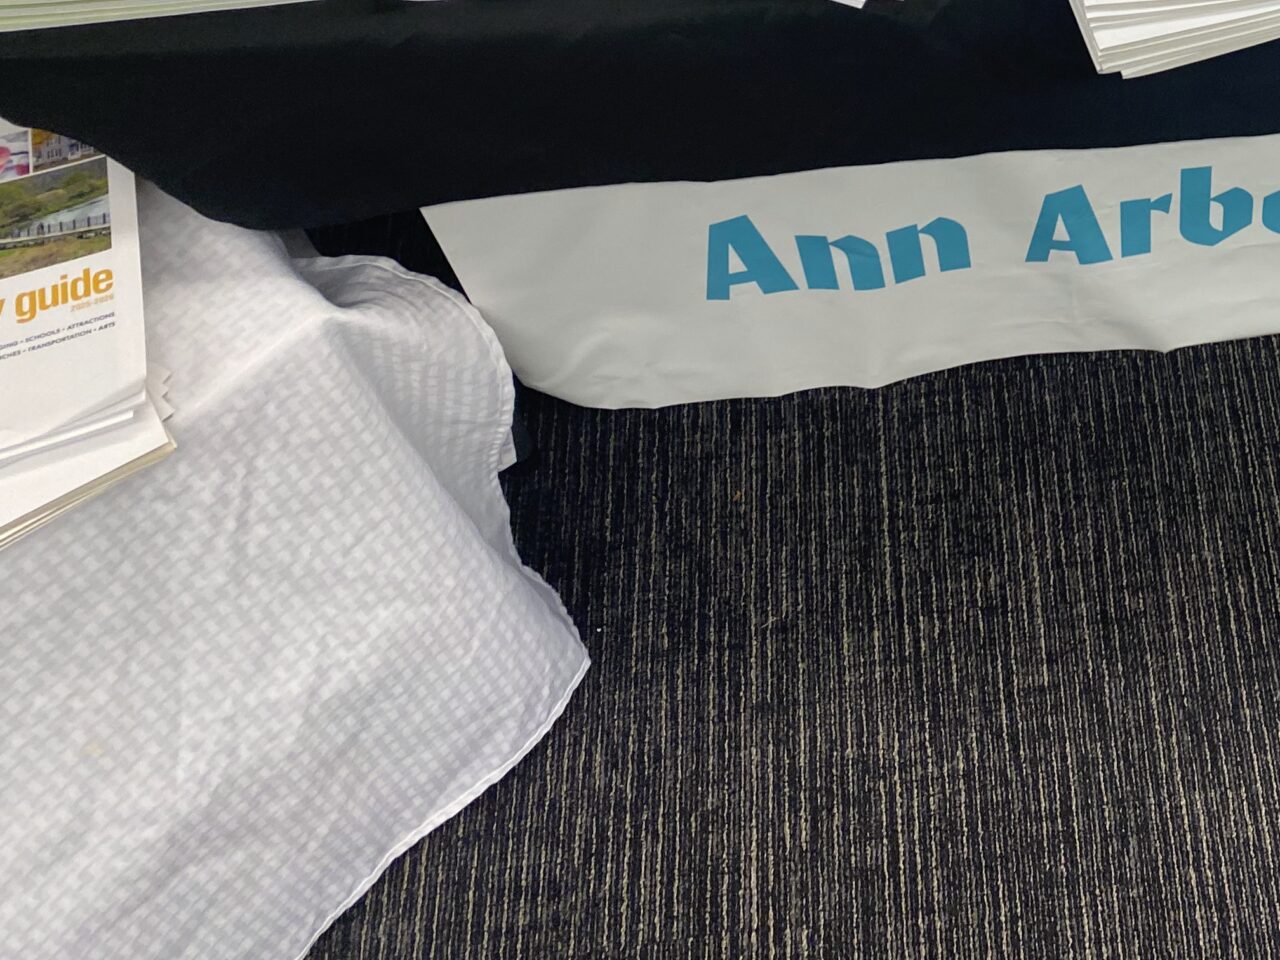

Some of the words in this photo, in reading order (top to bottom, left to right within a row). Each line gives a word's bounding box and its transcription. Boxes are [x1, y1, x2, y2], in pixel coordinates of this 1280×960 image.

[706, 214, 972, 300] Ann
[15, 267, 114, 324] guide
[25, 328, 60, 343] SCHOOLS
[67, 312, 115, 331] ATTRACTIONS
[28, 328, 92, 352] TRANSPORTATION
[98, 322, 116, 332] ARTS
